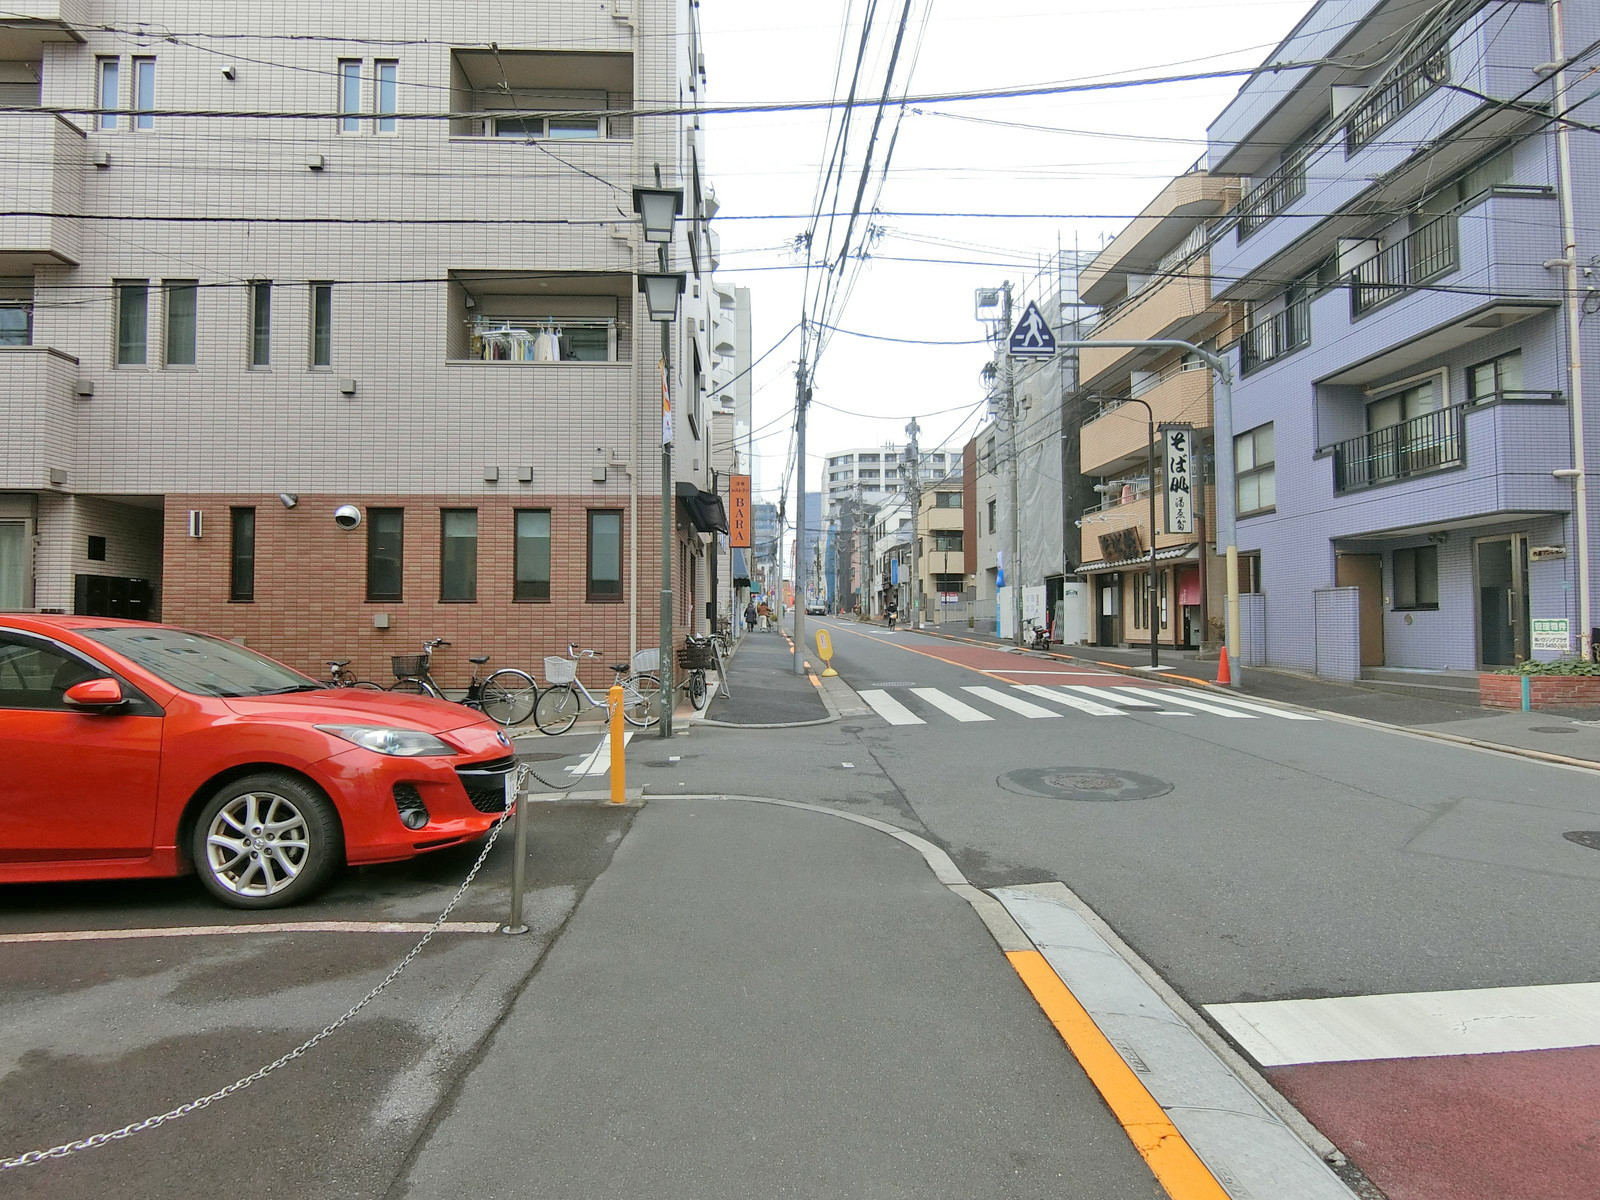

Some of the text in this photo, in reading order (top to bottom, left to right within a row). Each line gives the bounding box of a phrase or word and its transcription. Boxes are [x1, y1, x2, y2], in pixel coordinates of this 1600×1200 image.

[1170, 432, 1189, 494] そば処
[736, 498, 744, 540] BARA
